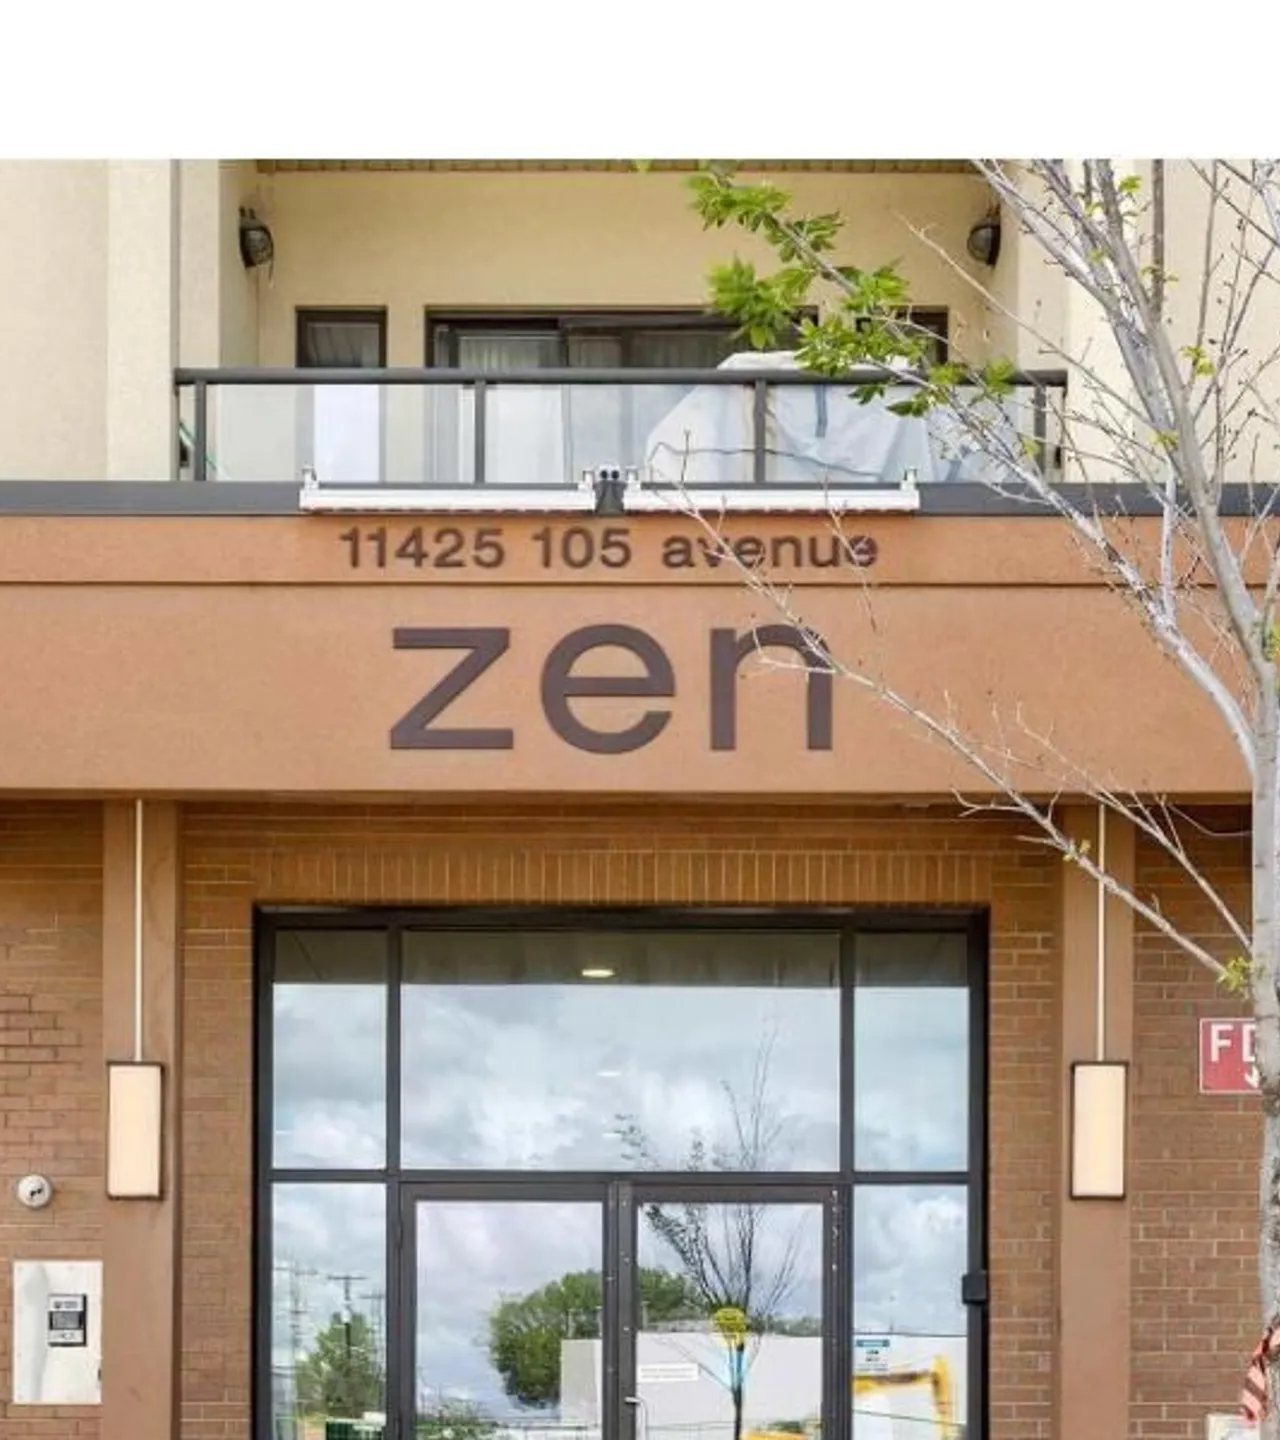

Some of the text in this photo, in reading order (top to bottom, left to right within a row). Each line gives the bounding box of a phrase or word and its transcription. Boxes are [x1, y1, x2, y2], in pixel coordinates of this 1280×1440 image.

[340, 527, 879, 569] 11425 105 avenue
[389, 623, 834, 755] zen
